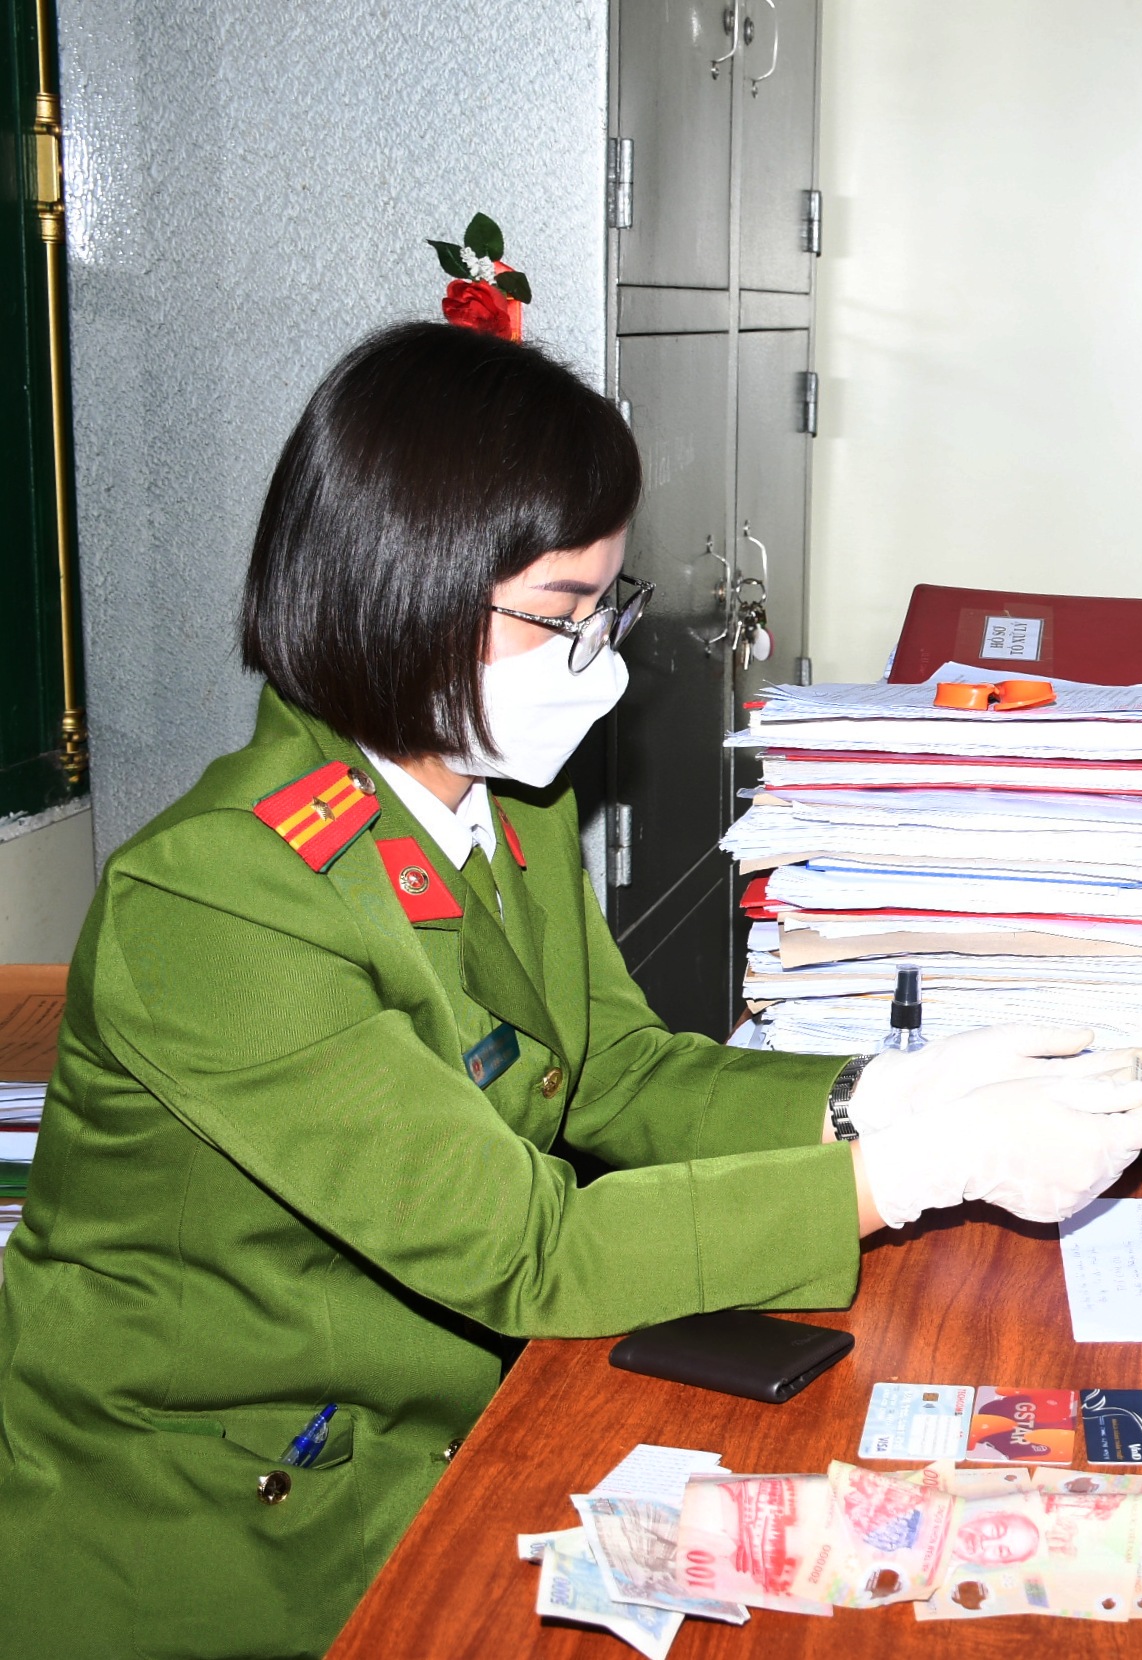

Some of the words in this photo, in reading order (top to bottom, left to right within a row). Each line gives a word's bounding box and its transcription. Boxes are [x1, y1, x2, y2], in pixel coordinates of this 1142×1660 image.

[1010, 1402, 1037, 1446] GSTAR
[876, 1435, 889, 1453] VISA
[686, 1551, 716, 1590] 100
